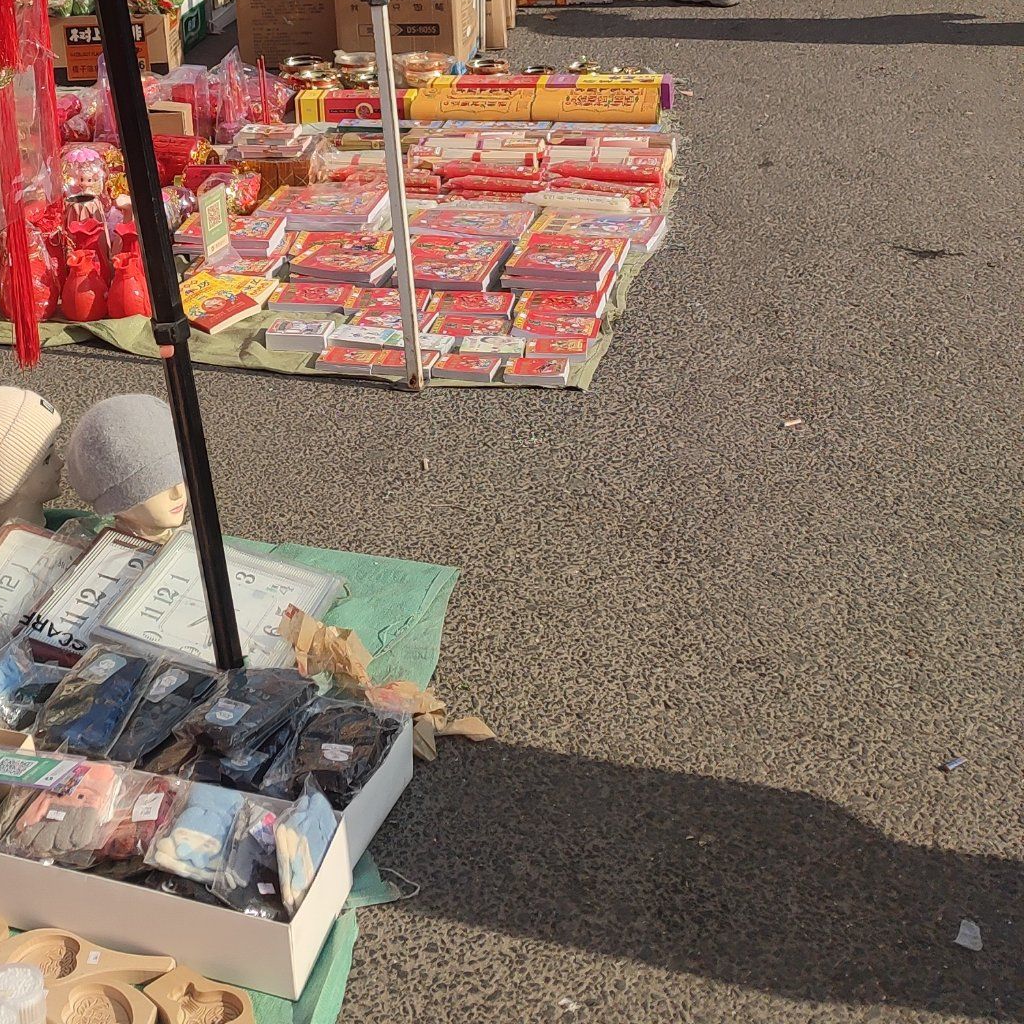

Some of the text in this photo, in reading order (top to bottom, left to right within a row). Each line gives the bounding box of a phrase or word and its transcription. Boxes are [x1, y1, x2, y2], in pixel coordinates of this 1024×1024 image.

[60, 557, 145, 629] 11 12 1 2
[141, 606, 165, 622] 11
[154, 586, 180, 606] 12
[170, 574, 191, 585] 1
[235, 570, 256, 585] 3
